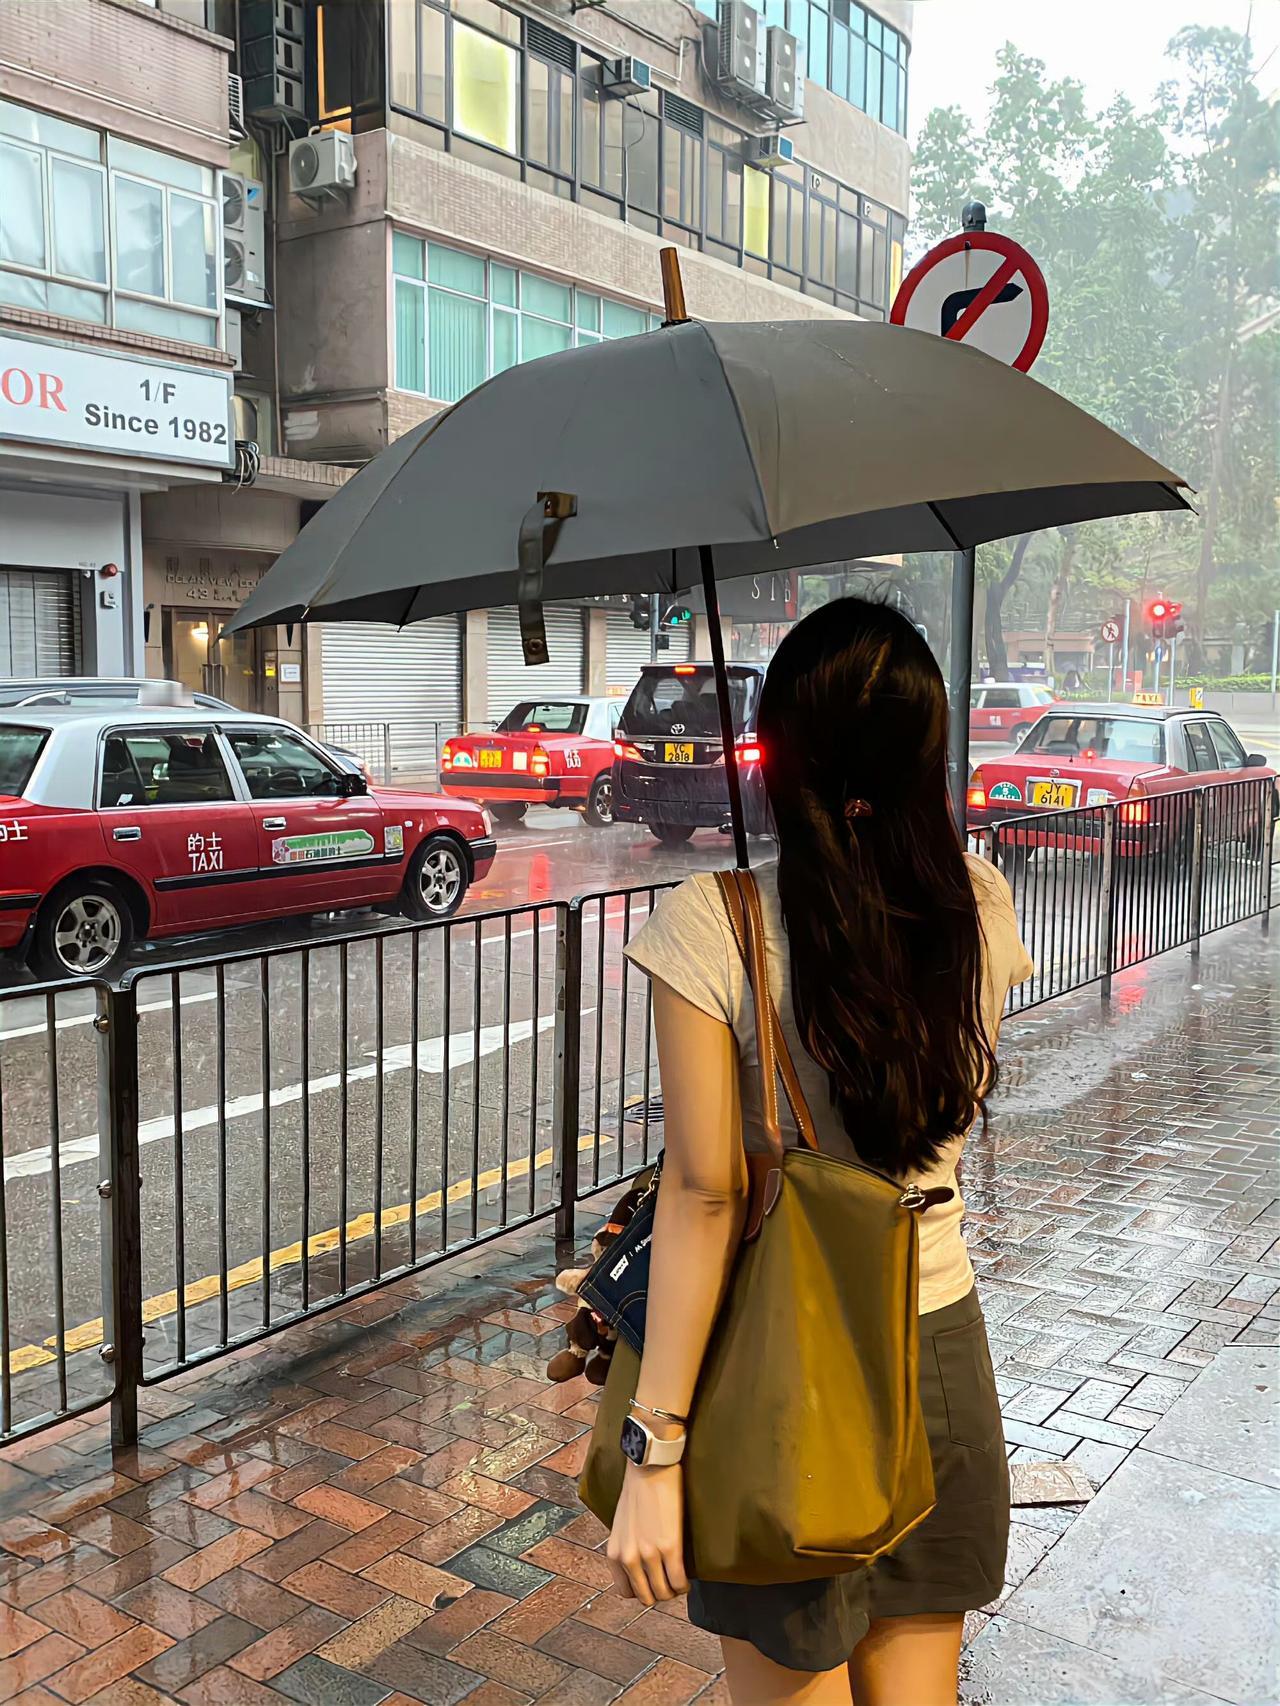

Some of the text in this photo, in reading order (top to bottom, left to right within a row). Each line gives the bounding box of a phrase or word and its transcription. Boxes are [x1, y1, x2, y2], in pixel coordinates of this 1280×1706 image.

[139, 378, 176, 404] 1/F
[84, 402, 227, 445] Since 1982
[673, 743, 685, 753] VC
[668, 752, 690, 762] 2818
[1045, 783, 1061, 795] JY
[1040, 794, 1065, 806] 6141
[187, 831, 222, 851] 的士
[188, 850, 223, 872] TAXI
